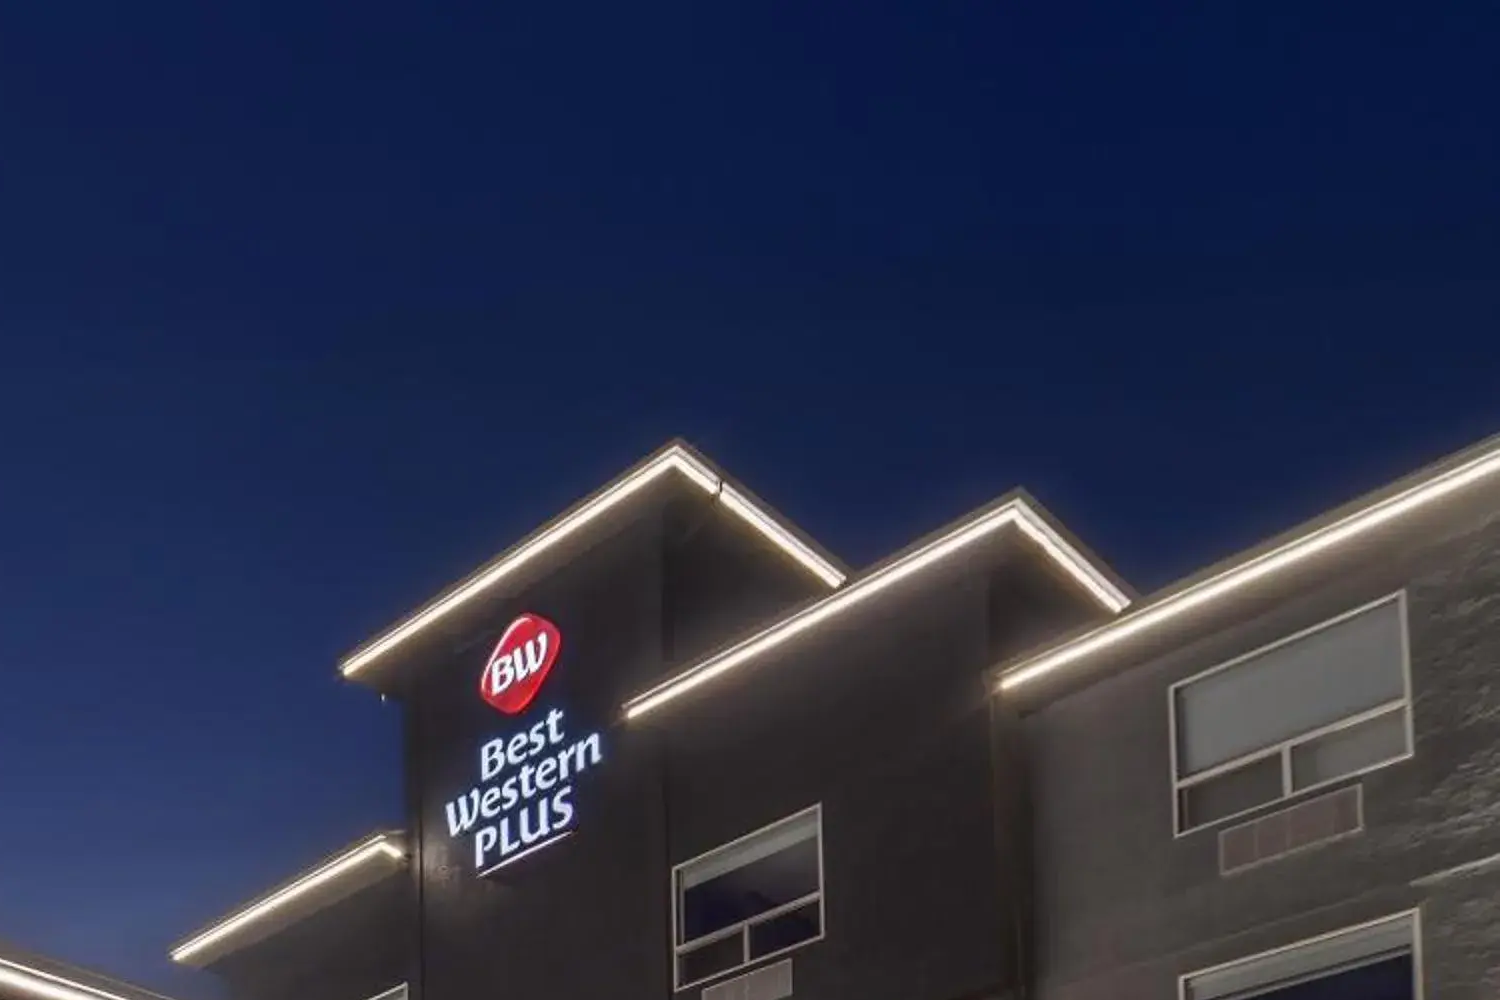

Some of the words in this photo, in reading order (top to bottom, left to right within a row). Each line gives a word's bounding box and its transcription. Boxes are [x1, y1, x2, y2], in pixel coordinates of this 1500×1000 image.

[491, 631, 548, 696] BW
[481, 708, 564, 782] Best
[445, 733, 602, 837] Western
[475, 786, 574, 868] PLUS
